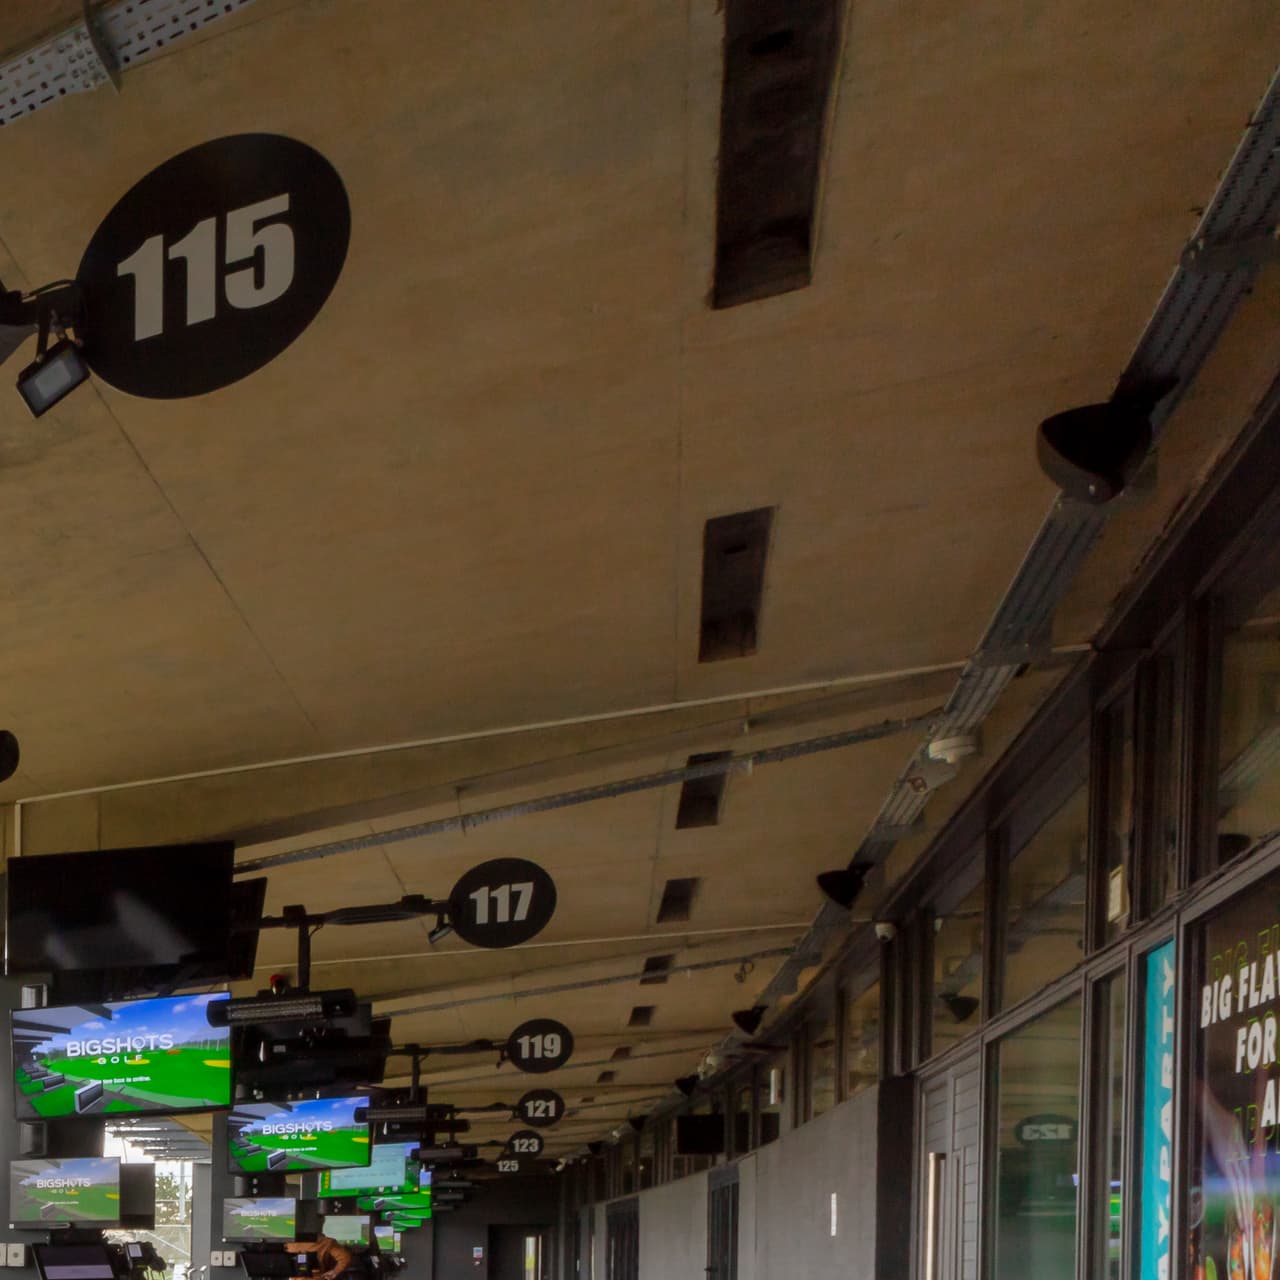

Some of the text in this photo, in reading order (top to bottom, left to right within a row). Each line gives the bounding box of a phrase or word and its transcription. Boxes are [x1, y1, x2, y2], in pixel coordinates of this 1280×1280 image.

[117, 192, 295, 342] 115
[469, 882, 534, 925] 117
[1200, 950, 1280, 1028] BIG FLA
[66, 1034, 174, 1057] BIGSHOTS
[517, 1033, 562, 1059] 119
[1235, 1016, 1277, 1074] FOR
[525, 1100, 556, 1117] 121
[262, 1120, 333, 1135] BIGSHOTS
[512, 1138, 539, 1152] 123
[497, 1160, 519, 1172] 125
[36, 1177, 91, 1189] BIGSHOTS
